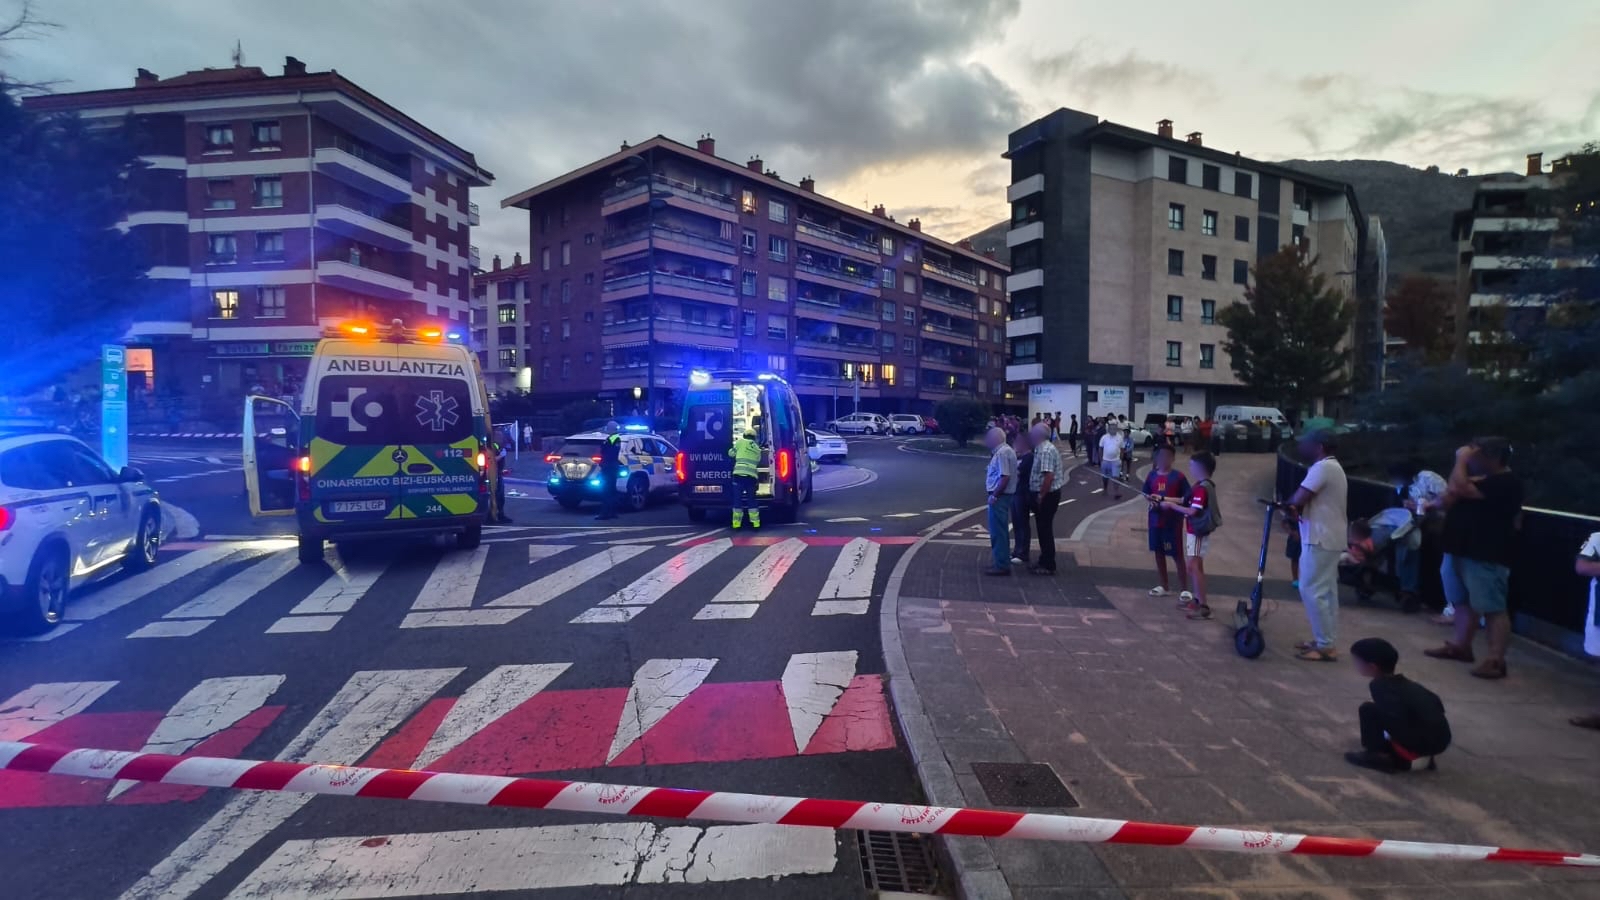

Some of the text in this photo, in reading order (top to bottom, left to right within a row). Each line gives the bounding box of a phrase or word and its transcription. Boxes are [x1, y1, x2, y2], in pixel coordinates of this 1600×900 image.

[327, 359, 465, 377] ANBULANTZIA
[443, 449, 463, 458] 112
[317, 474, 475, 489] OINARRIZKO BIZI-EUSKARRIA
[336, 502, 362, 512] 7175
[426, 505, 442, 513] 244
